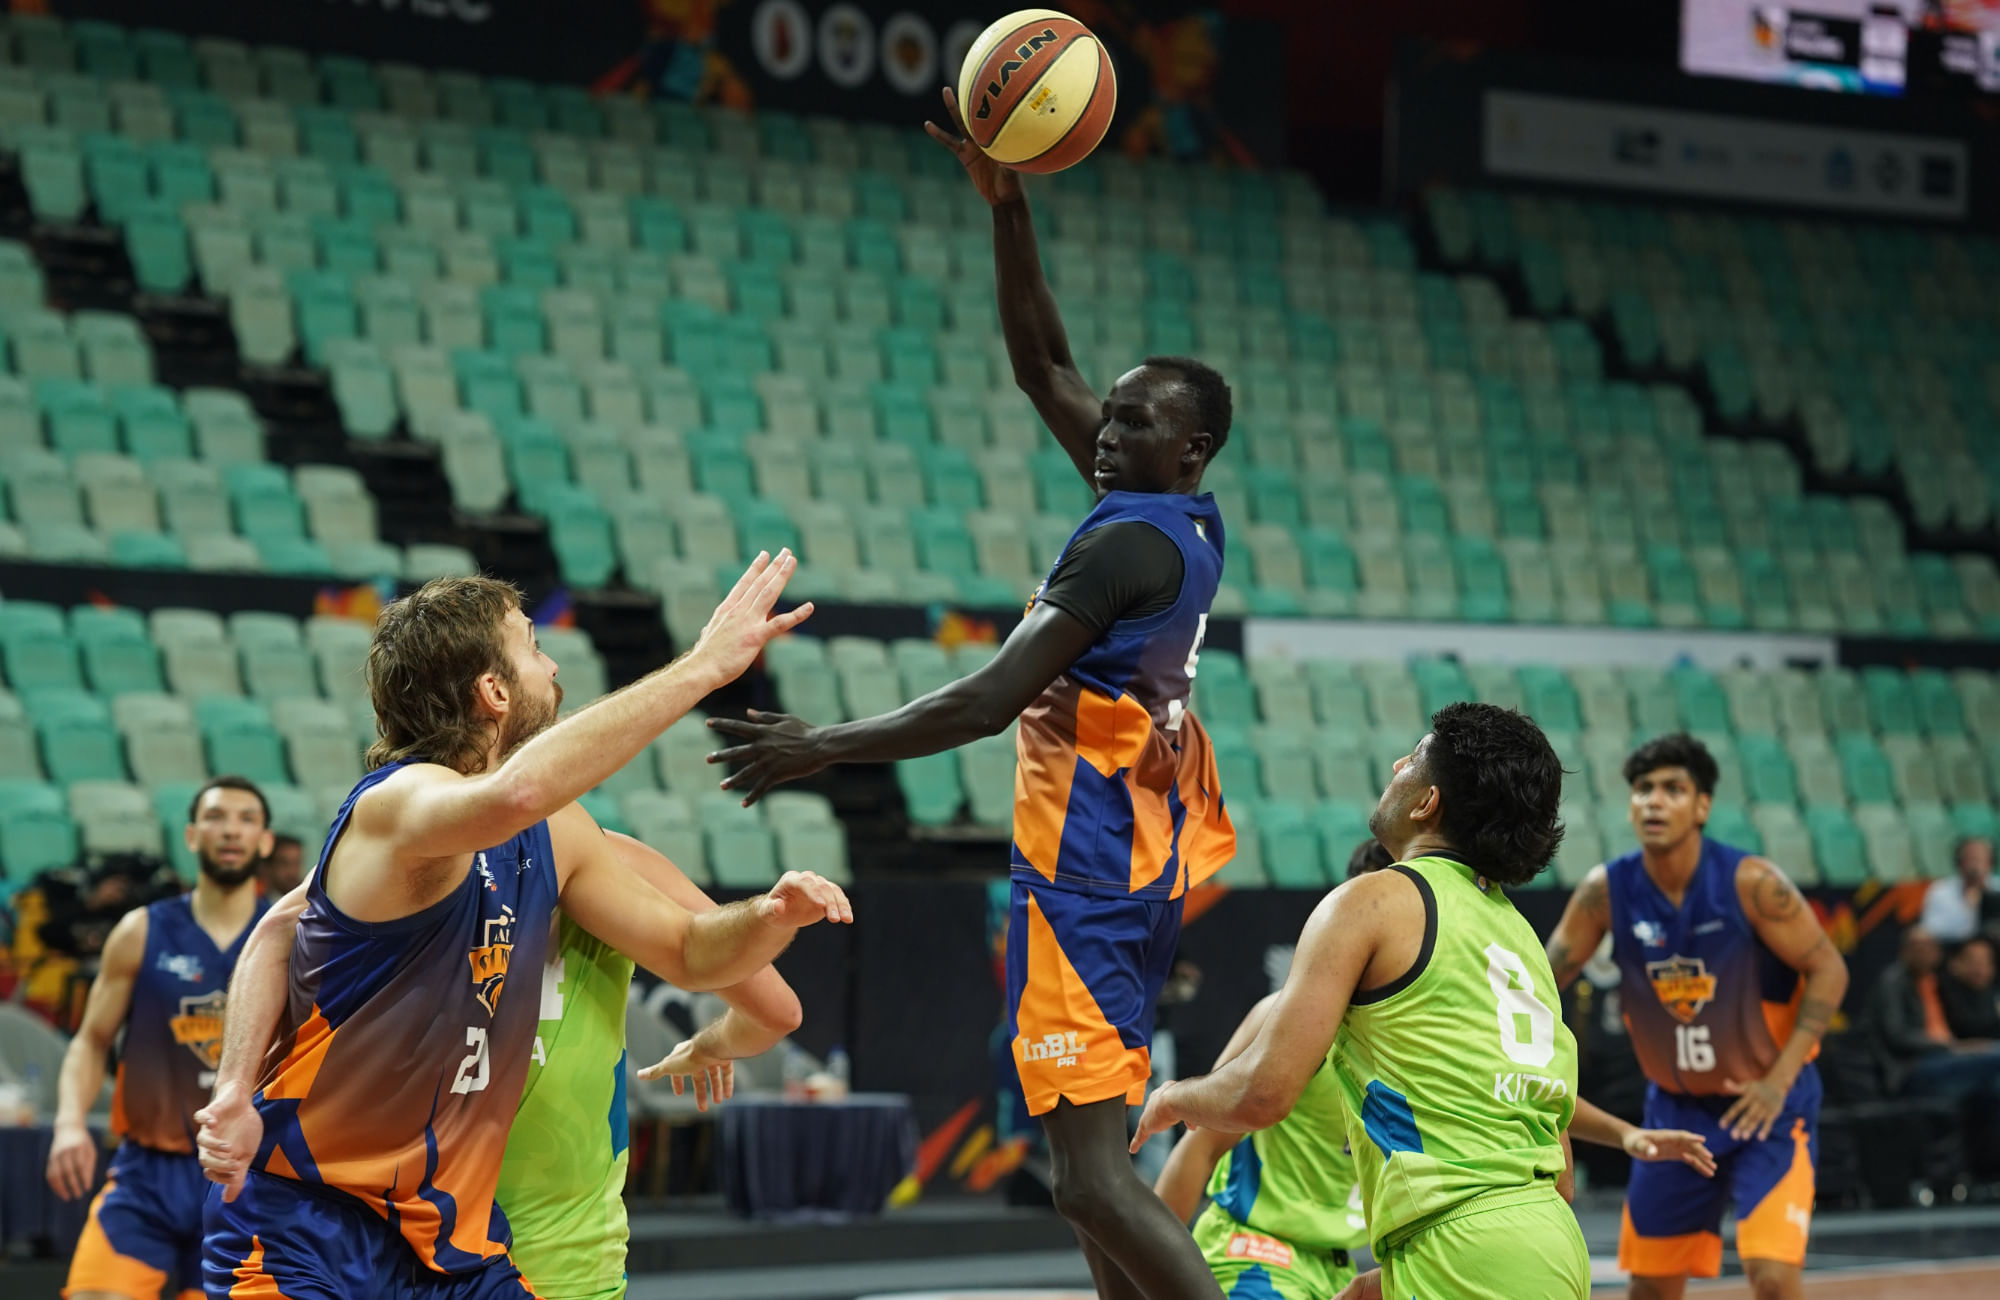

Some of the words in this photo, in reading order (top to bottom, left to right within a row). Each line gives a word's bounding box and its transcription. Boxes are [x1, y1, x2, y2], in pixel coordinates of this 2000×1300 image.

[976, 27, 1059, 119] NIVIA
[1484, 941, 1555, 1069] 8
[1022, 1030, 1087, 1063] InBL
[1675, 1023, 1716, 1072] 16
